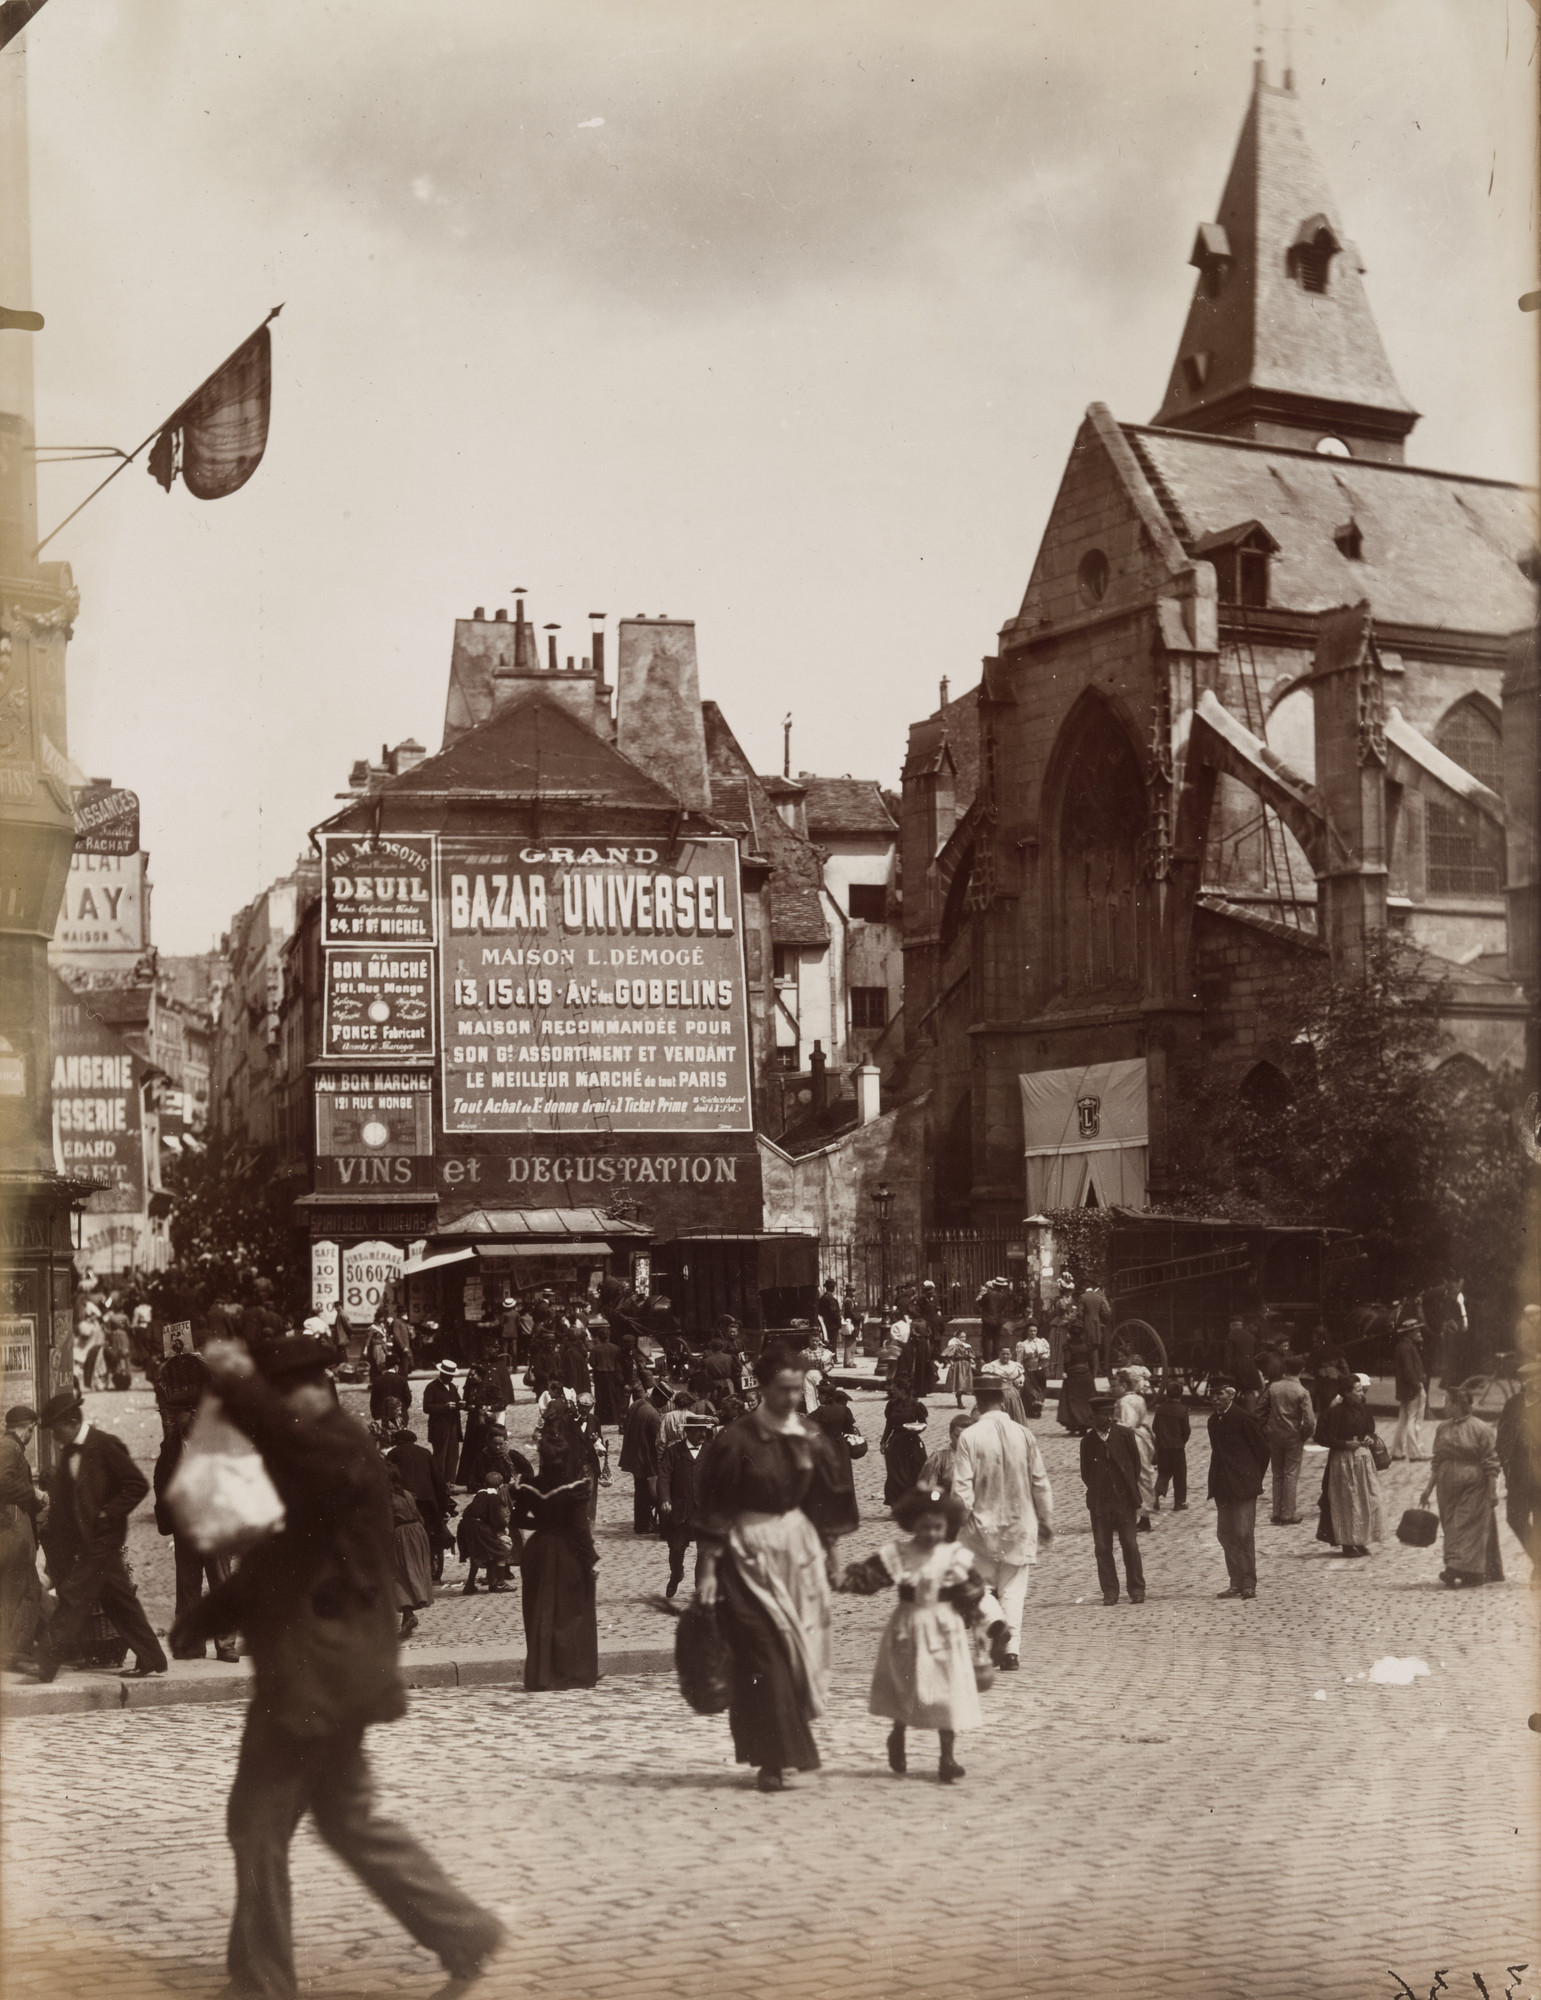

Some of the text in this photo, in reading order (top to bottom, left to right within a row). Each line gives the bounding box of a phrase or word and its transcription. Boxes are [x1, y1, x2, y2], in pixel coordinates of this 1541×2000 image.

[73, 788, 138, 834] AISSANCES
[86, 837, 131, 851] RACHAT
[330, 840, 430, 872] AU MOSOTIS
[519, 847, 659, 864] GRAND
[332, 877, 429, 901] DEUIL
[451, 874, 735, 932] BAZAR UNIVERSEL
[62, 930, 109, 942] MAISON
[381, 919, 426, 935] MICHEL
[481, 948, 574, 965] MAISON
[333, 959, 428, 978] BON MARCHÉ
[358, 982, 380, 993] Rue
[384, 982, 424, 997] Monge
[615, 978, 733, 1005] GOBELINS
[332, 1025, 425, 1042] FONCE Fabricant
[458, 1017, 731, 1035] MAISON RECOMMANDÉE POUR
[453, 1046, 488, 1063] SON
[519, 1046, 632, 1062] ASSORTIMENT
[638, 1046, 656, 1062] ET
[664, 1046, 736, 1062] VENDANT
[52, 1055, 133, 1089] ANGERIE
[466, 1068, 727, 1088] LE MEILLEUR MARCHÉ de tout PARIS
[340, 1073, 369, 1091] BON
[352, 1097, 373, 1109] RUE
[379, 1097, 412, 1109] MONGE
[453, 1097, 482, 1114] Tout
[483, 1097, 522, 1114] Achat
[544, 1099, 579, 1113] donne
[581, 1097, 611, 1113] droit
[624, 1097, 657, 1113] Ticket
[657, 1097, 688, 1113] Prime
[63, 1140, 116, 1158] EDARD
[334, 1156, 738, 1184] VINS et DEGUSTATION
[316, 1265, 335, 1276] 10
[316, 1283, 333, 1294] 15
[347, 1287, 380, 1306] 80
